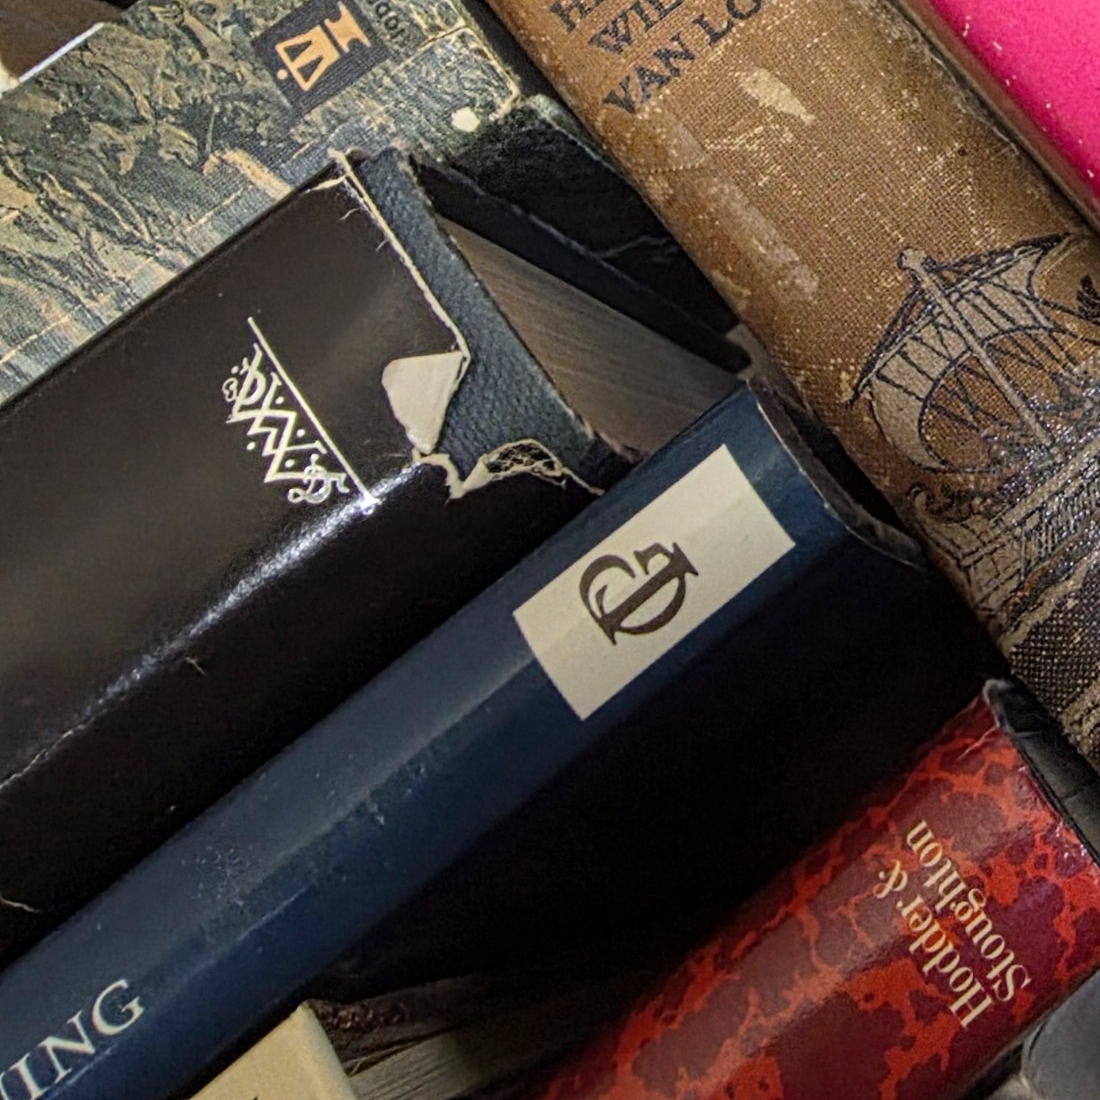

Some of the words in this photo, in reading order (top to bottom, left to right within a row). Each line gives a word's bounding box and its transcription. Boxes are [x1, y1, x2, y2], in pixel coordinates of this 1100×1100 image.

[603, 34, 696, 115] VAN
[874, 859, 909, 899] &
[905, 819, 1032, 1002] Stoughton
[896, 895, 996, 1029] Hodder
[0, 979, 145, 1100] ING
